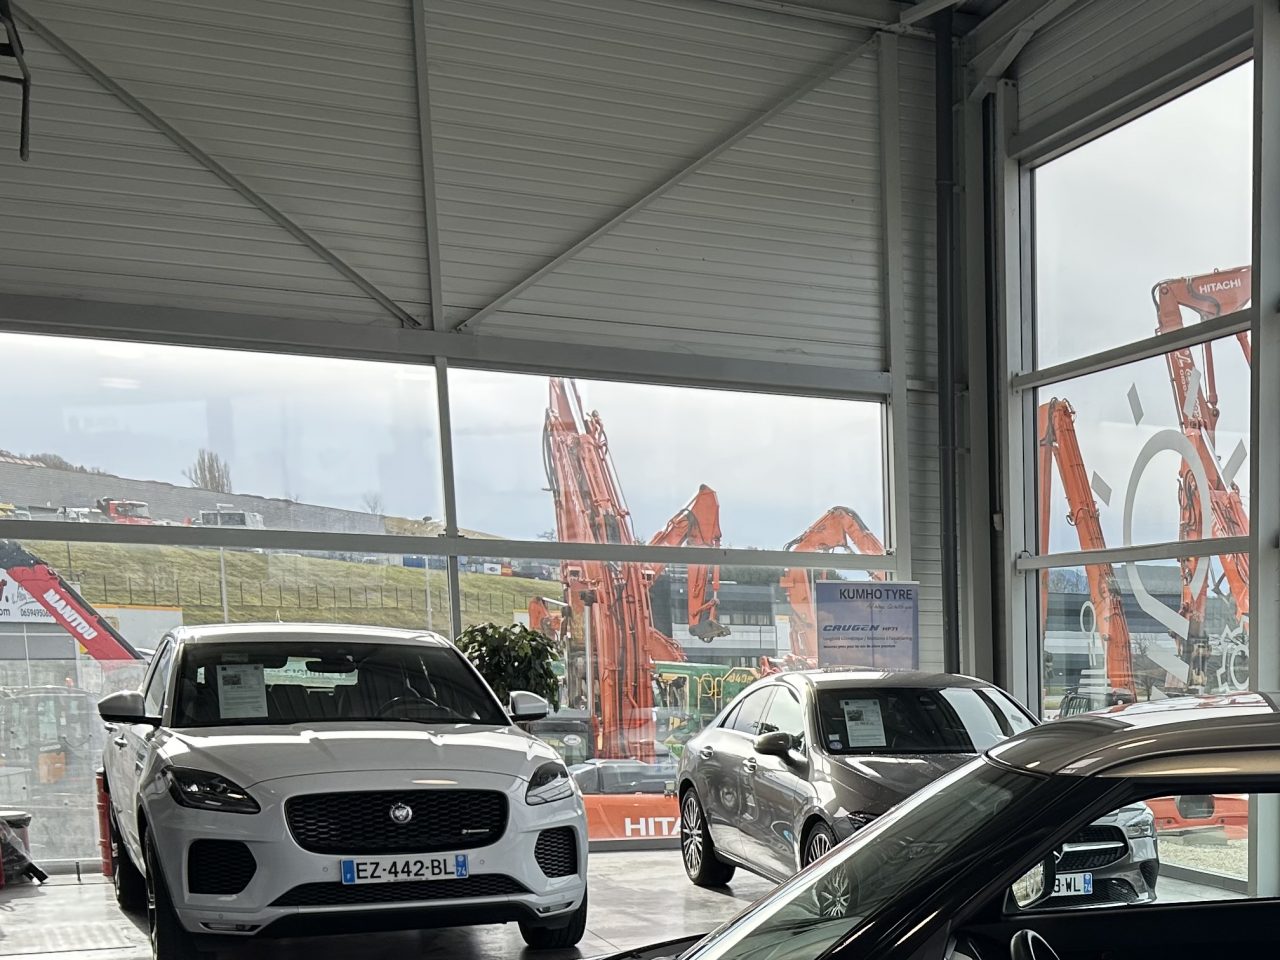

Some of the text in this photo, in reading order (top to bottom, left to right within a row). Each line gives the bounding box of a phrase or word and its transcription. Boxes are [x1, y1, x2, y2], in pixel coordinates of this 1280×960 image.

[1199, 278, 1242, 295] HITACHI
[839, 588, 912, 600] KUMHO TYRE
[43, 588, 98, 640] MANITOU
[355, 858, 455, 880] EZ-442-BL
[456, 867, 467, 876] 74
